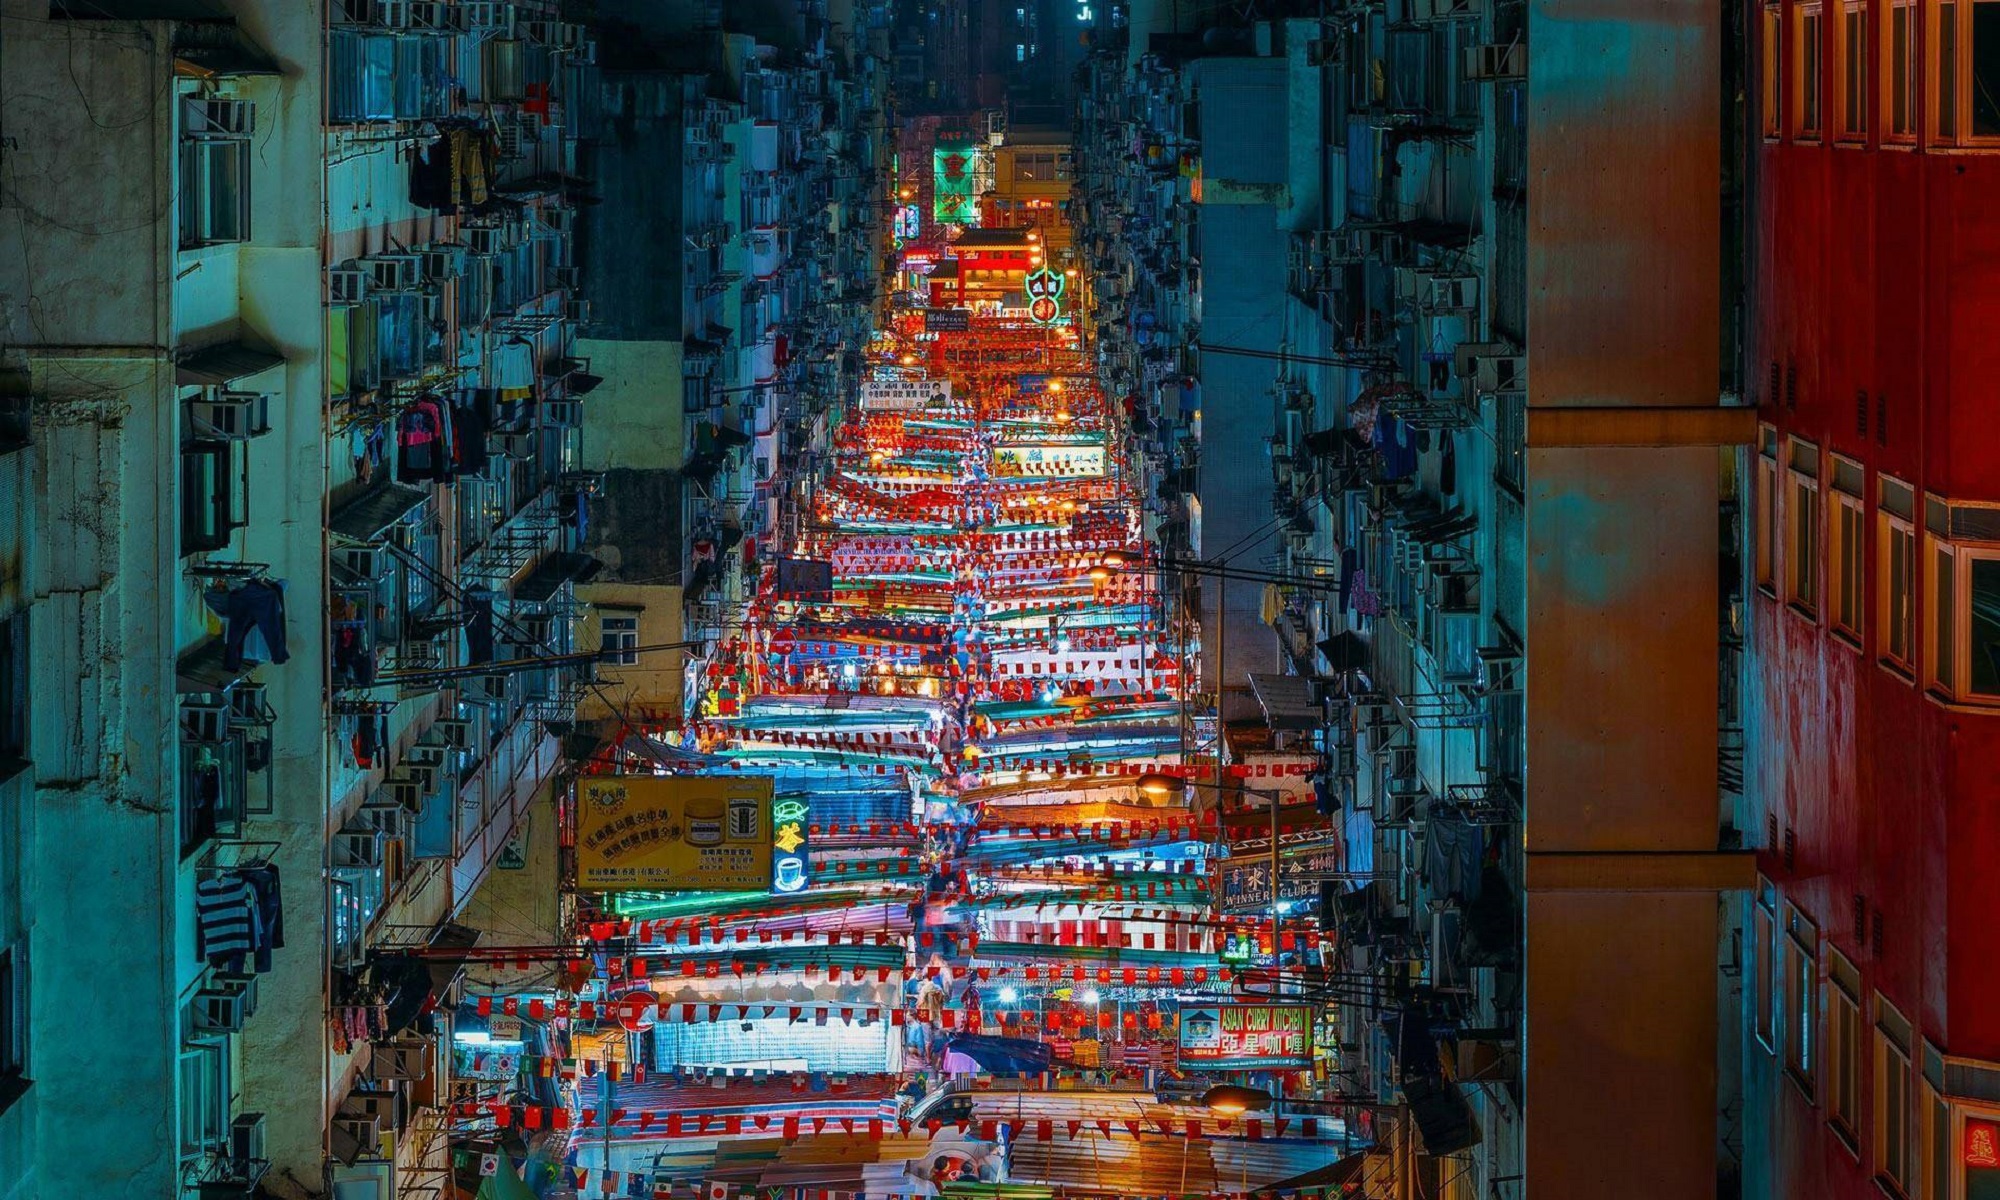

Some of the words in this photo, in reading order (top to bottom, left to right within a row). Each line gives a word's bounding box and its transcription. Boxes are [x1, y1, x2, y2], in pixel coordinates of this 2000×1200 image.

[1280, 885, 1308, 897] CLUB
[1222, 1008, 1244, 1031] ASIAN
[1247, 1008, 1270, 1031] CURRY
[1273, 1008, 1304, 1031] KITCHEN
[1221, 1033, 1305, 1056] 亞星咖喱
